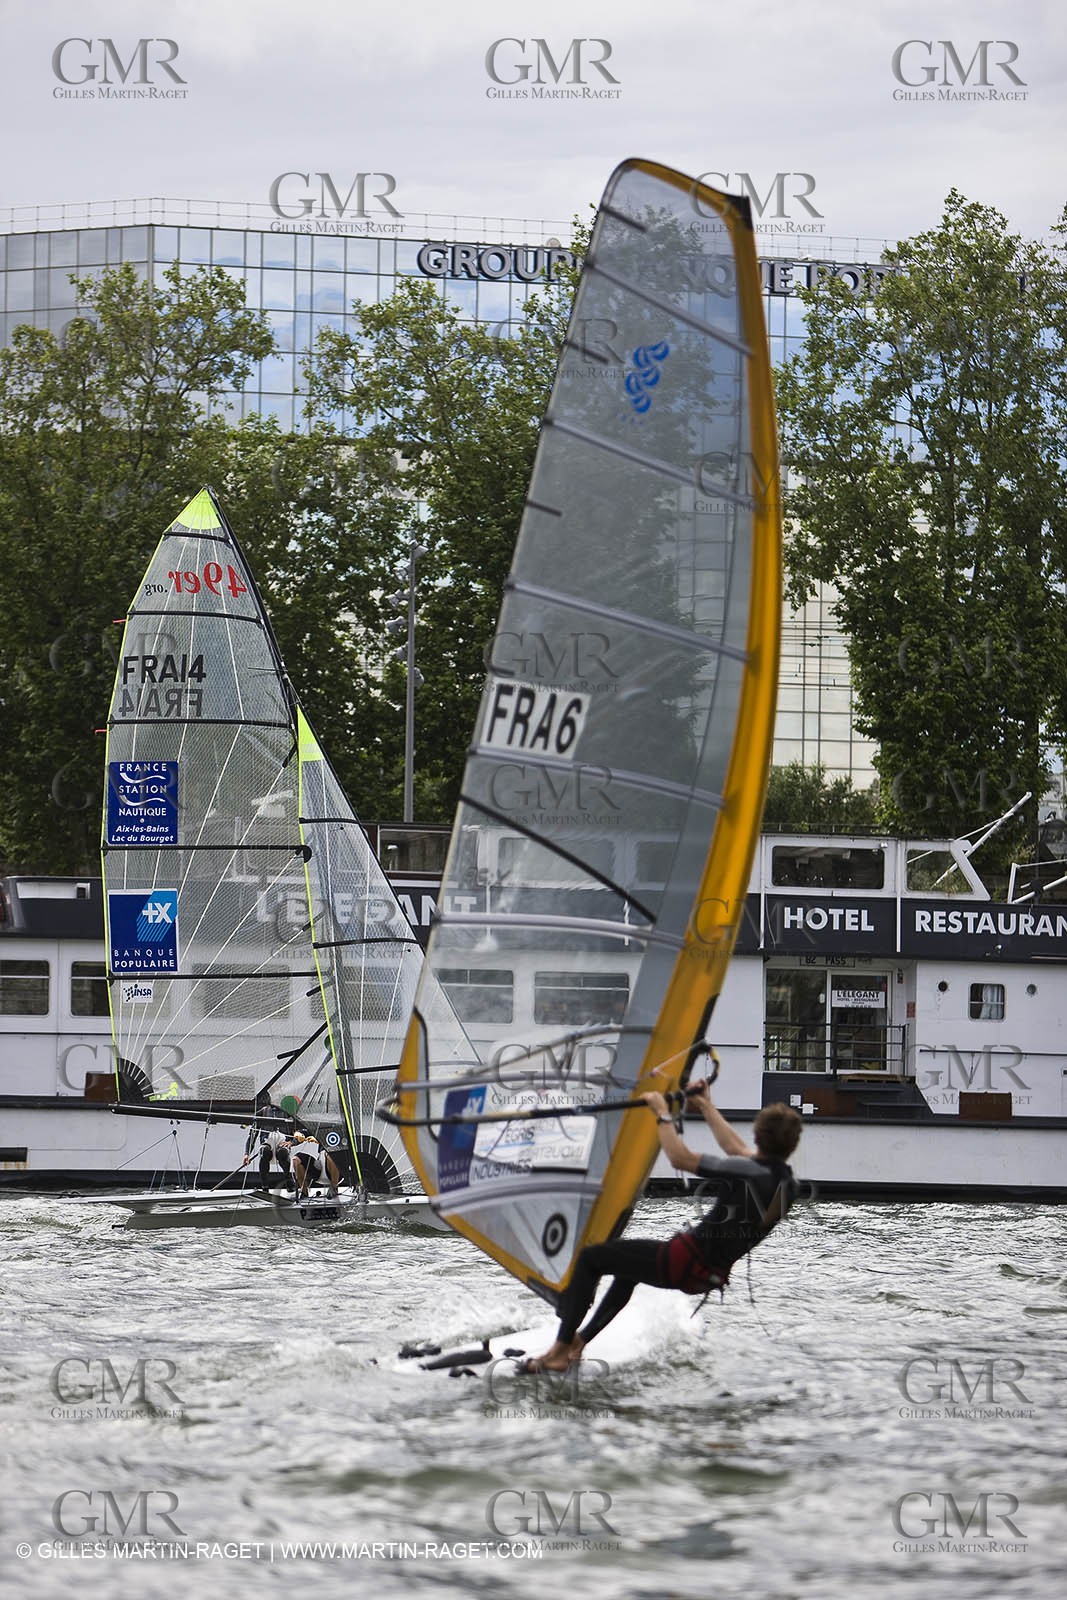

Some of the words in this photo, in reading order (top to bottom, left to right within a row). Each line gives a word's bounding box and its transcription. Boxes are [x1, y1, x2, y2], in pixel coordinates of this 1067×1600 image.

[417, 243, 582, 281] GROUP
[122, 654, 206, 685] FRA14
[486, 683, 582, 754] FRA6
[119, 763, 167, 772] FRANCE
[118, 785, 167, 794] STATION
[118, 808, 167, 817] NAUTIQUE
[115, 825, 169, 833] Aix-les-Bains
[140, 834, 174, 844] Bourget
[783, 907, 875, 932] HOTEL
[114, 949, 173, 957] BANQUE
[114, 960, 175, 968] POPULAIRE
